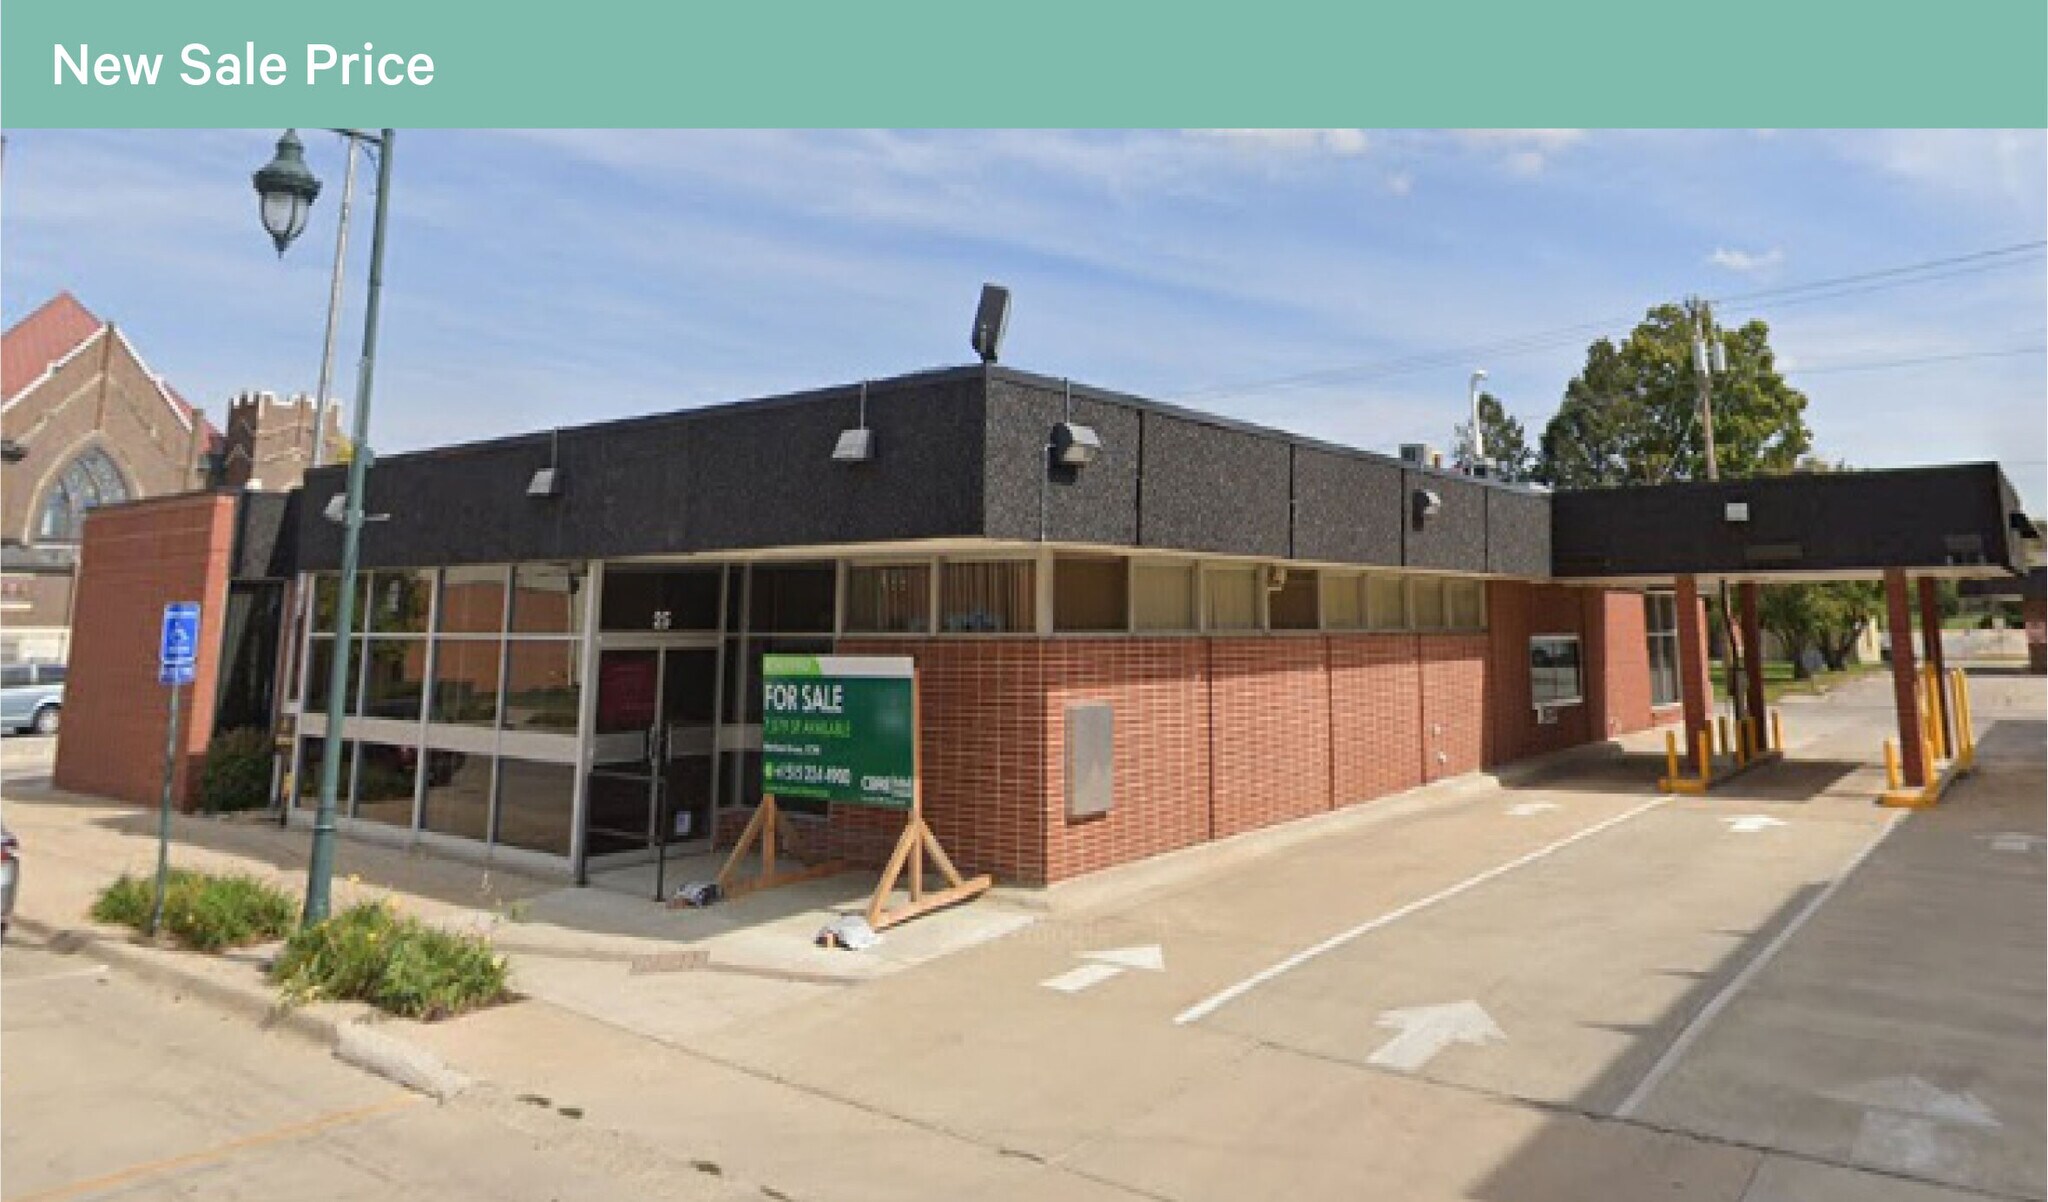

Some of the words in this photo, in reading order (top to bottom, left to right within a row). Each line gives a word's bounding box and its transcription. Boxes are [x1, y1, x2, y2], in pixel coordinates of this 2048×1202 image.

[764, 684, 798, 711] FOR
[801, 684, 843, 713] SALE
[803, 719, 851, 739] AVAILABLE
